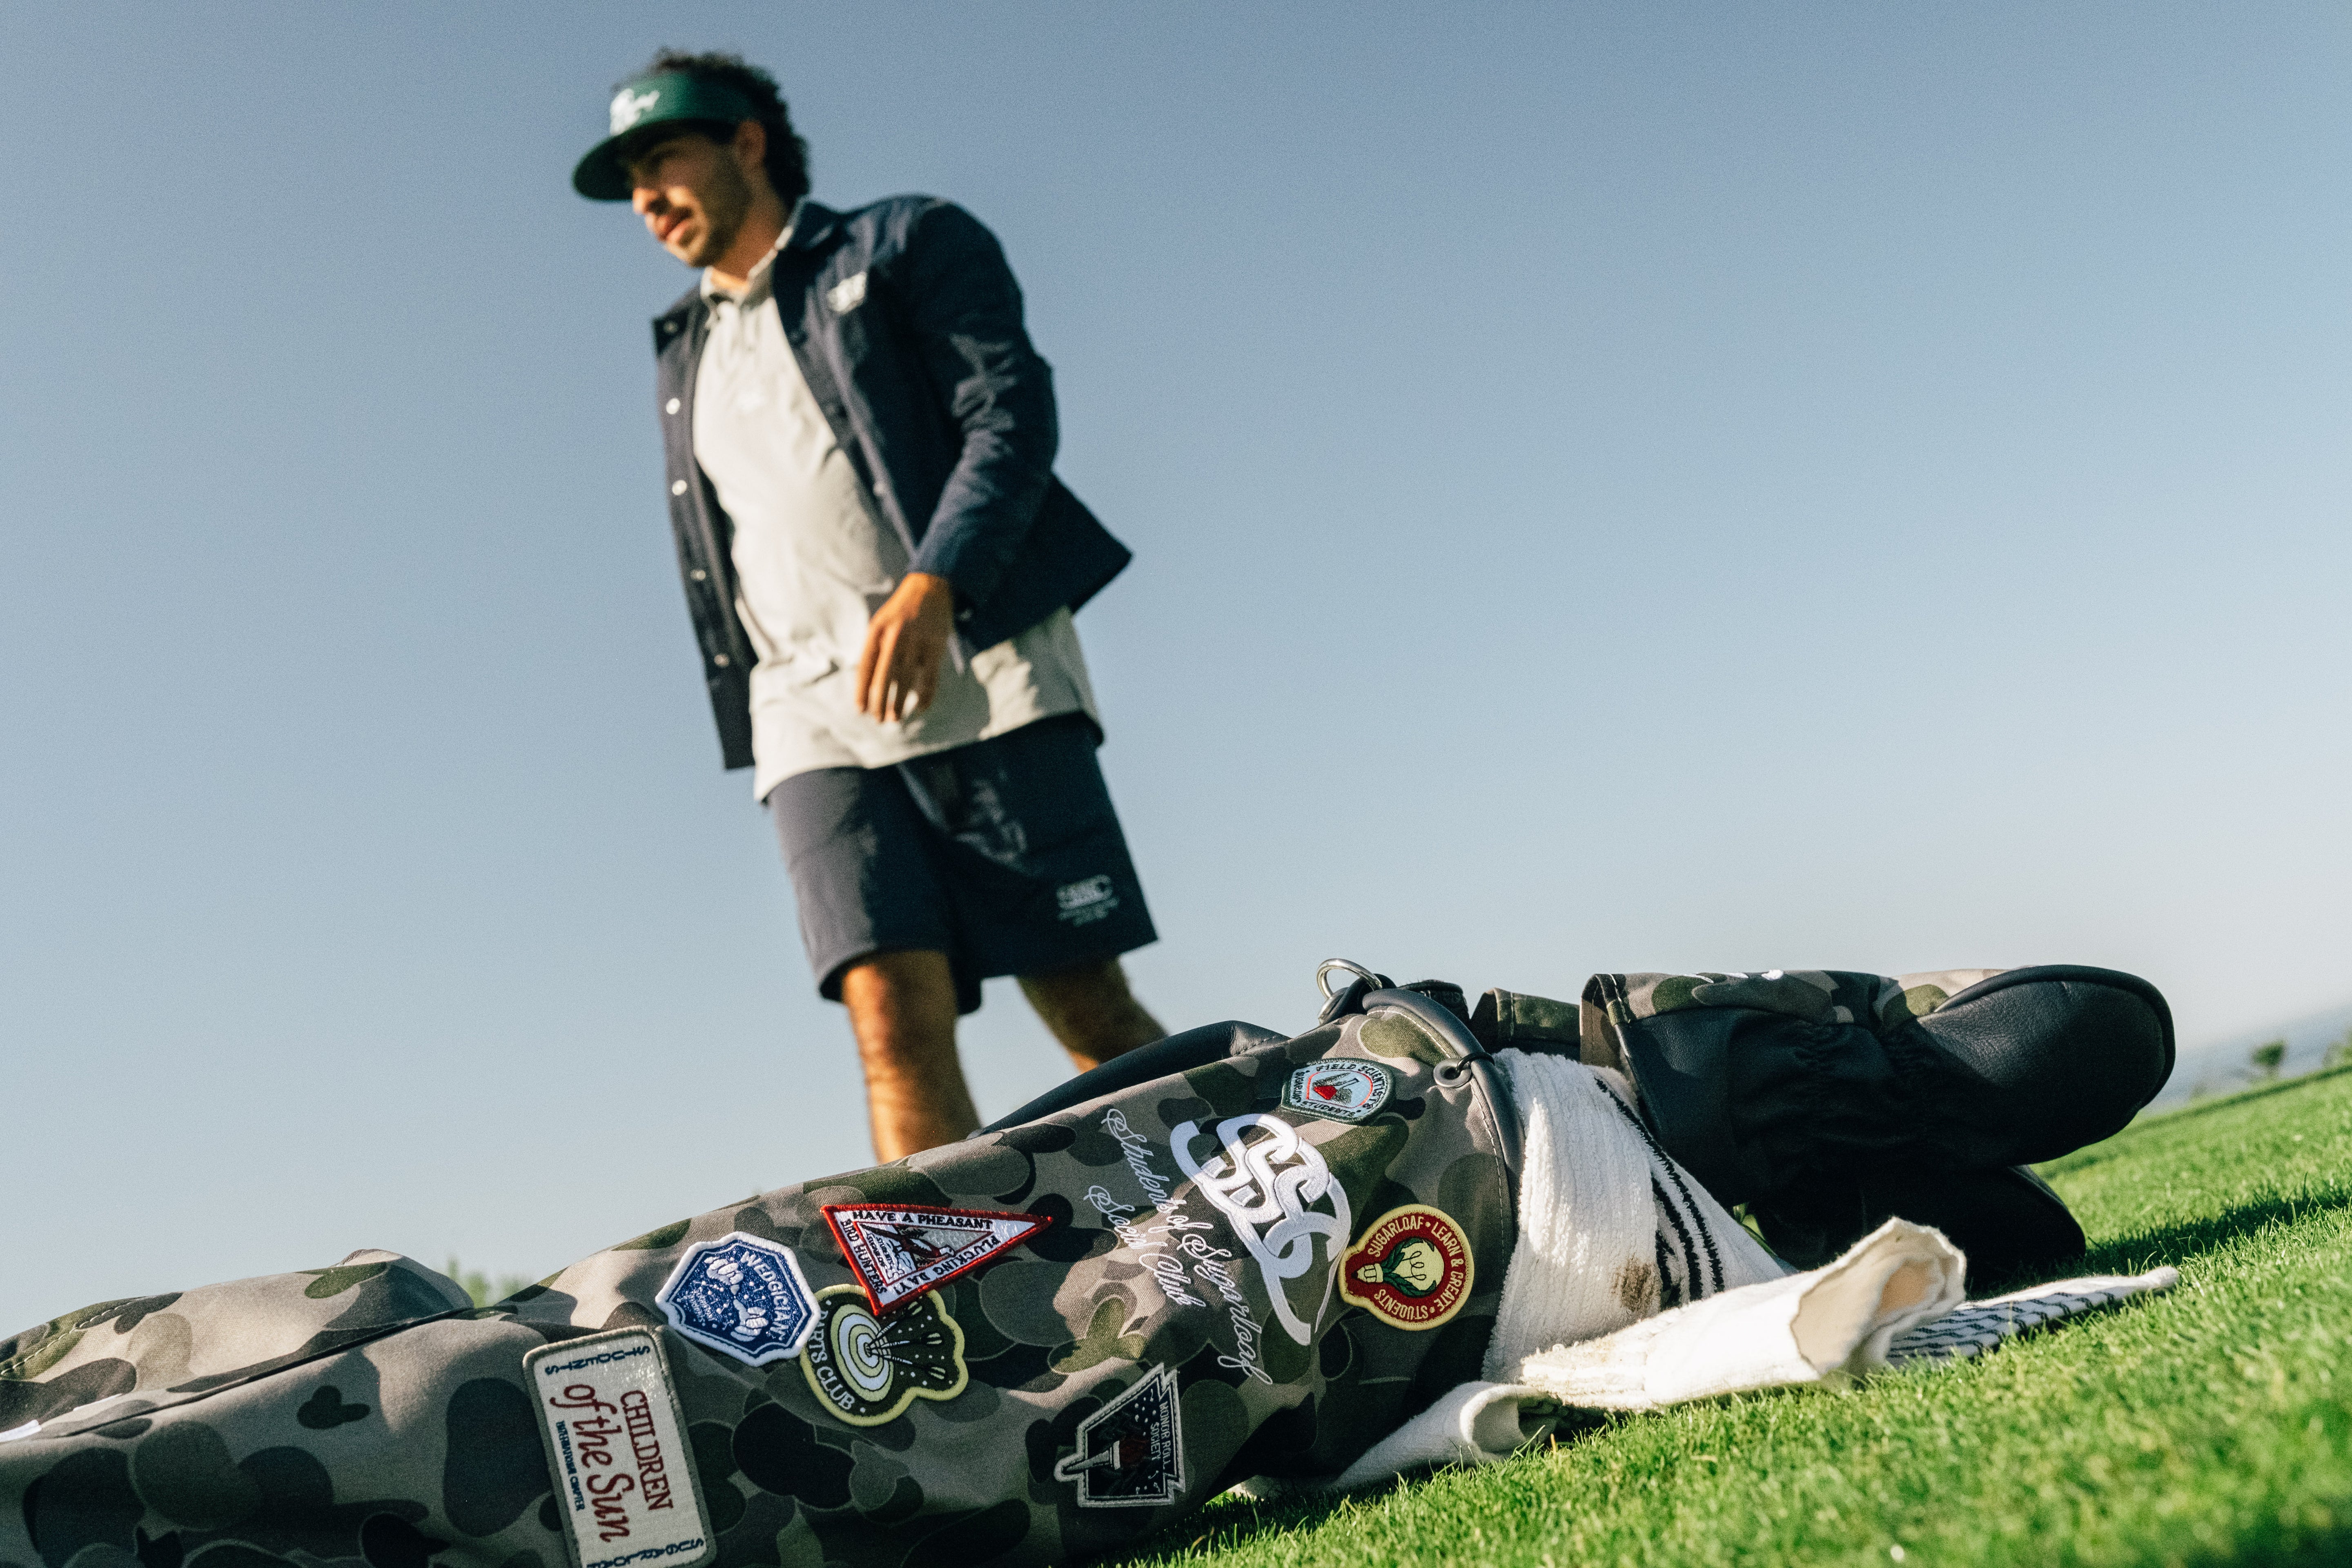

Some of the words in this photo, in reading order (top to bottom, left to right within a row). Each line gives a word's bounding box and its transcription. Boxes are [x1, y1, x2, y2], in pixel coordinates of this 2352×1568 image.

[1358, 1066, 1385, 1109] SCIENTISTS
[1301, 1101, 1356, 1116] STUDENTS
[1101, 1108, 1187, 1213] Students
[853, 1211, 896, 1222] HAVE
[902, 1213, 914, 1223] A
[918, 1215, 993, 1230] PHEASANT
[1148, 1215, 1214, 1233] of
[1368, 1215, 1424, 1257] SUGARLOAF
[1430, 1222, 1461, 1257] LEARN
[840, 1218, 859, 1242] BIRD
[853, 1243, 887, 1294] HUNTERS
[933, 1236, 1000, 1275] PLUCKING
[1084, 1185, 1168, 1250] Social
[1139, 1252, 1206, 1307] Club
[1451, 1258, 1464, 1267] &
[740, 1251, 791, 1337] WEDGICIAN
[894, 1272, 930, 1295] DAY!
[1433, 1271, 1463, 1312] CREATE
[1177, 1234, 1273, 1385] Sugarloaf
[1374, 1289, 1428, 1320] STUDENTS
[545, 1345, 650, 1375] STUDENTS
[549, 1384, 617, 1414] of
[817, 1366, 855, 1410] CLUB
[1160, 1401, 1170, 1439] HONOR
[572, 1415, 623, 1468] the
[619, 1389, 674, 1511] CHILDREN
[1151, 1422, 1161, 1461] SOCIETY
[1162, 1441, 1172, 1470] ROLL
[586, 1473, 635, 1543] Sun
